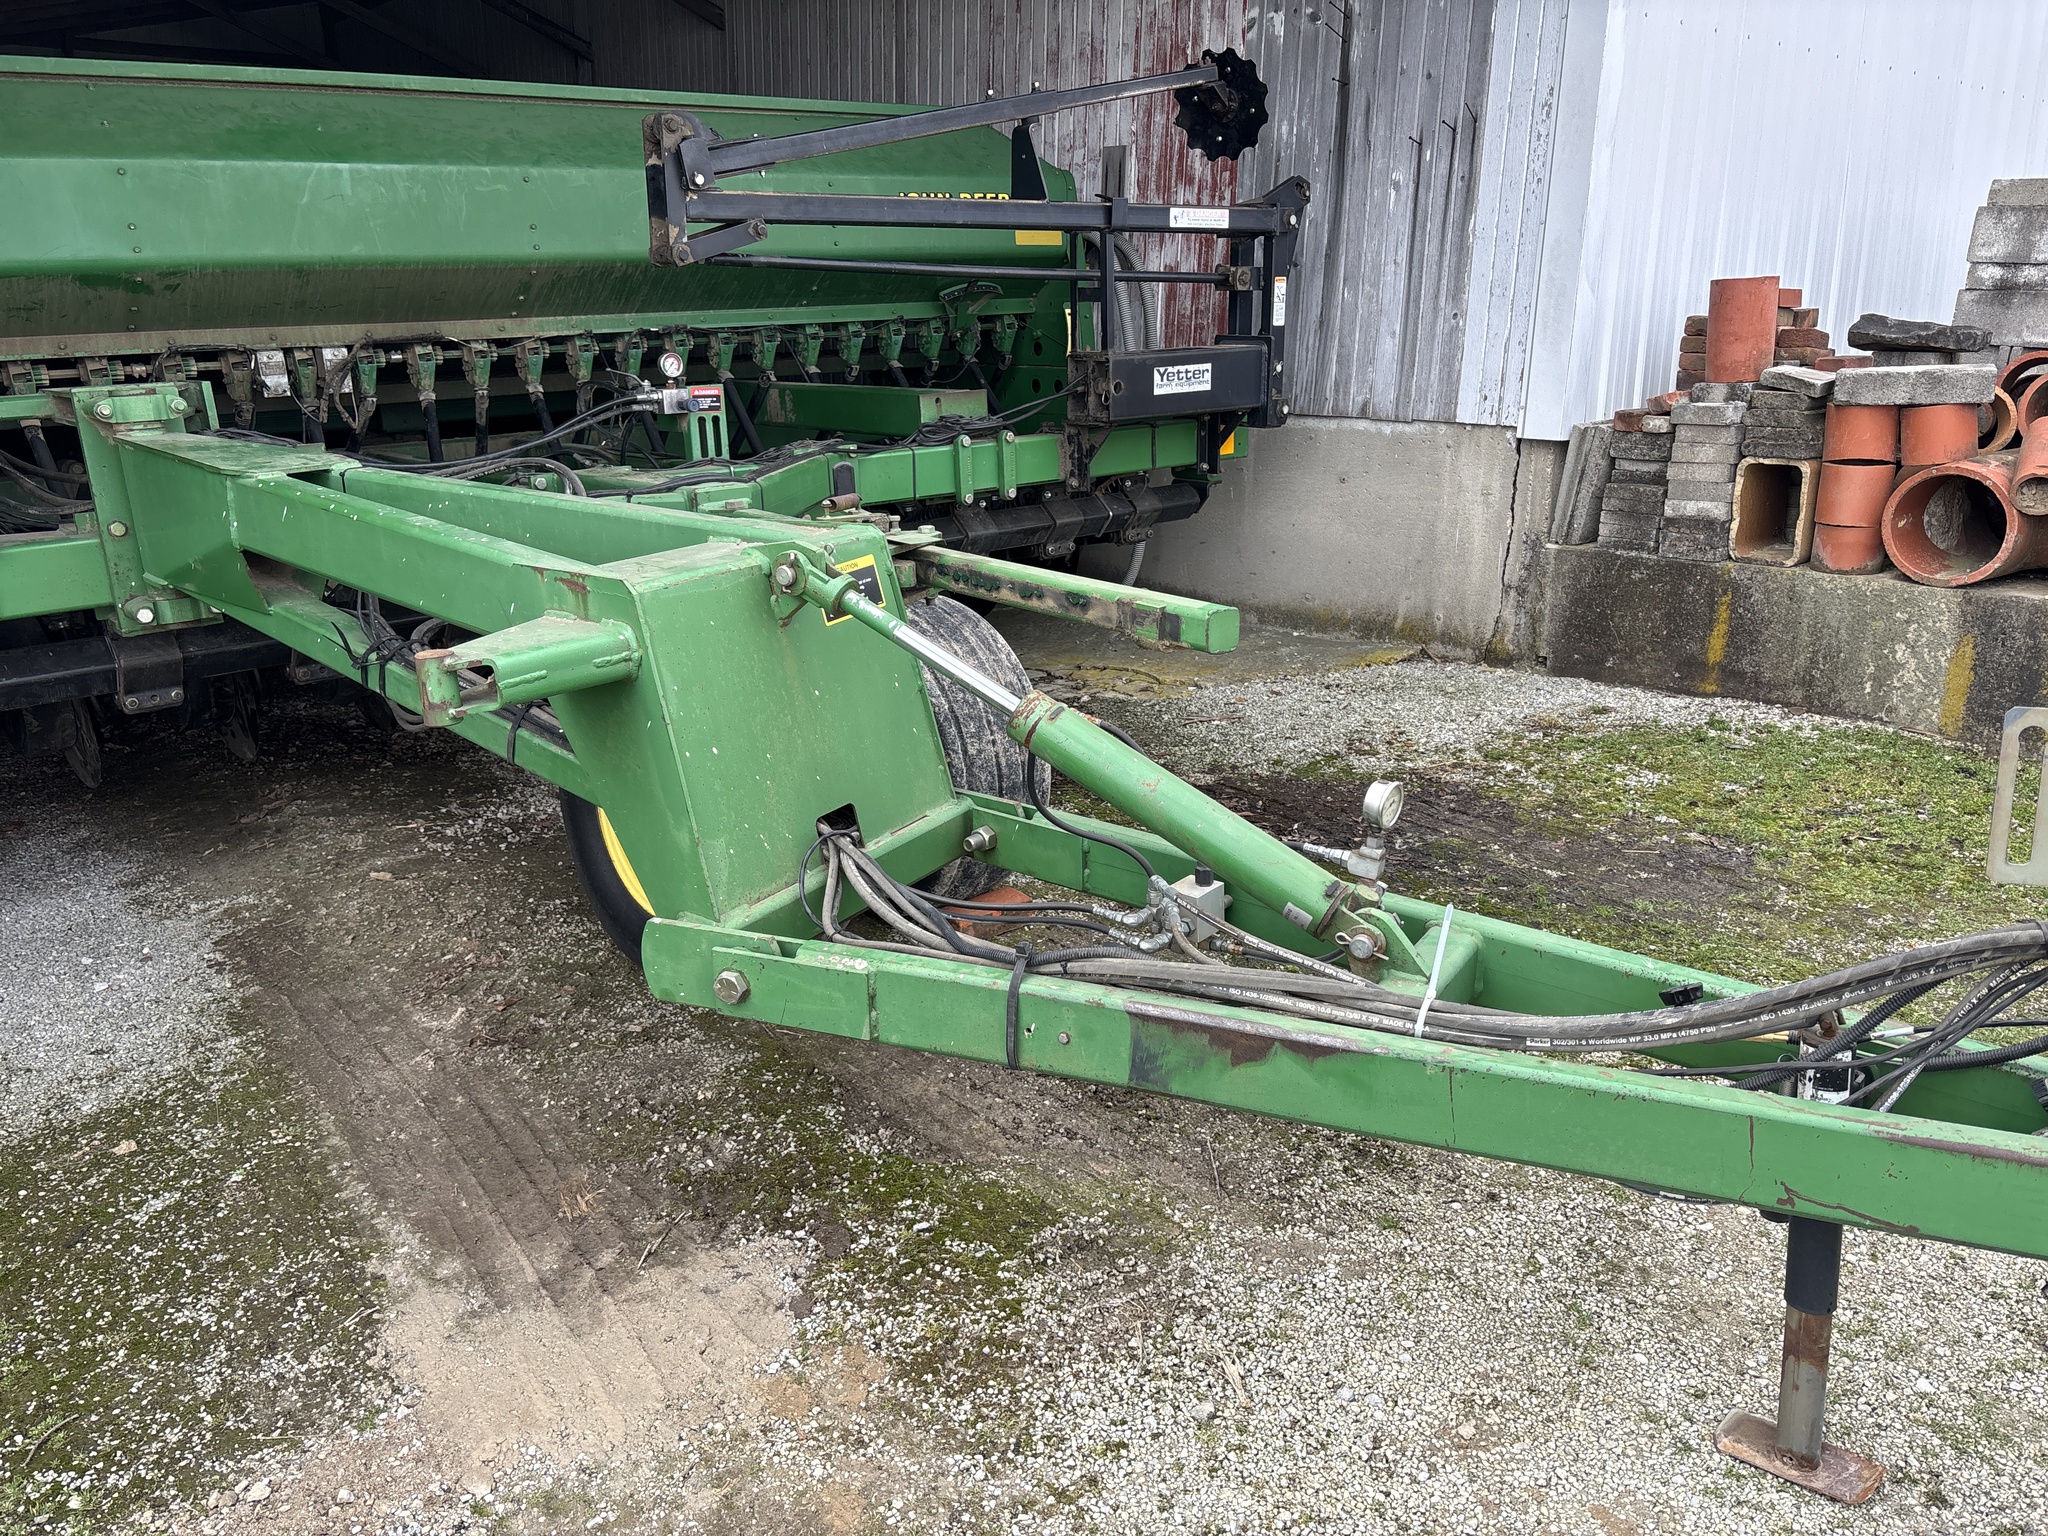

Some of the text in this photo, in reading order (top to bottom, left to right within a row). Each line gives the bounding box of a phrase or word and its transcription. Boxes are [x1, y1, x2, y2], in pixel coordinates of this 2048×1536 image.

[1156, 368, 1210, 382] Yetter
[1174, 379, 1210, 388] equipment
[1278, 949, 1304, 964] Worldwide
[1990, 970, 2012, 988] MADE
[2011, 962, 2022, 973] IN
[1760, 1012, 1776, 1022] ISO
[1901, 971, 1921, 983] (3/8)
[1921, 969, 1929, 977] X
[1229, 987, 1242, 996] ISO
[1296, 1002, 1316, 1011] 100R2
[1332, 1010, 1346, 1018] mm
[1368, 1015, 1381, 1023] 2W
[1383, 1018, 1404, 1028] MADE
[1405, 1022, 1413, 1030] IN
[1552, 1038, 1587, 1046] 302/301-6
[1588, 1036, 1628, 1045] Worldwide
[1628, 1035, 1642, 1043] WP
[1660, 1031, 1678, 1040] MPa
[1678, 1027, 1700, 1037] (4750
[1700, 1025, 1717, 1034] PSI)
